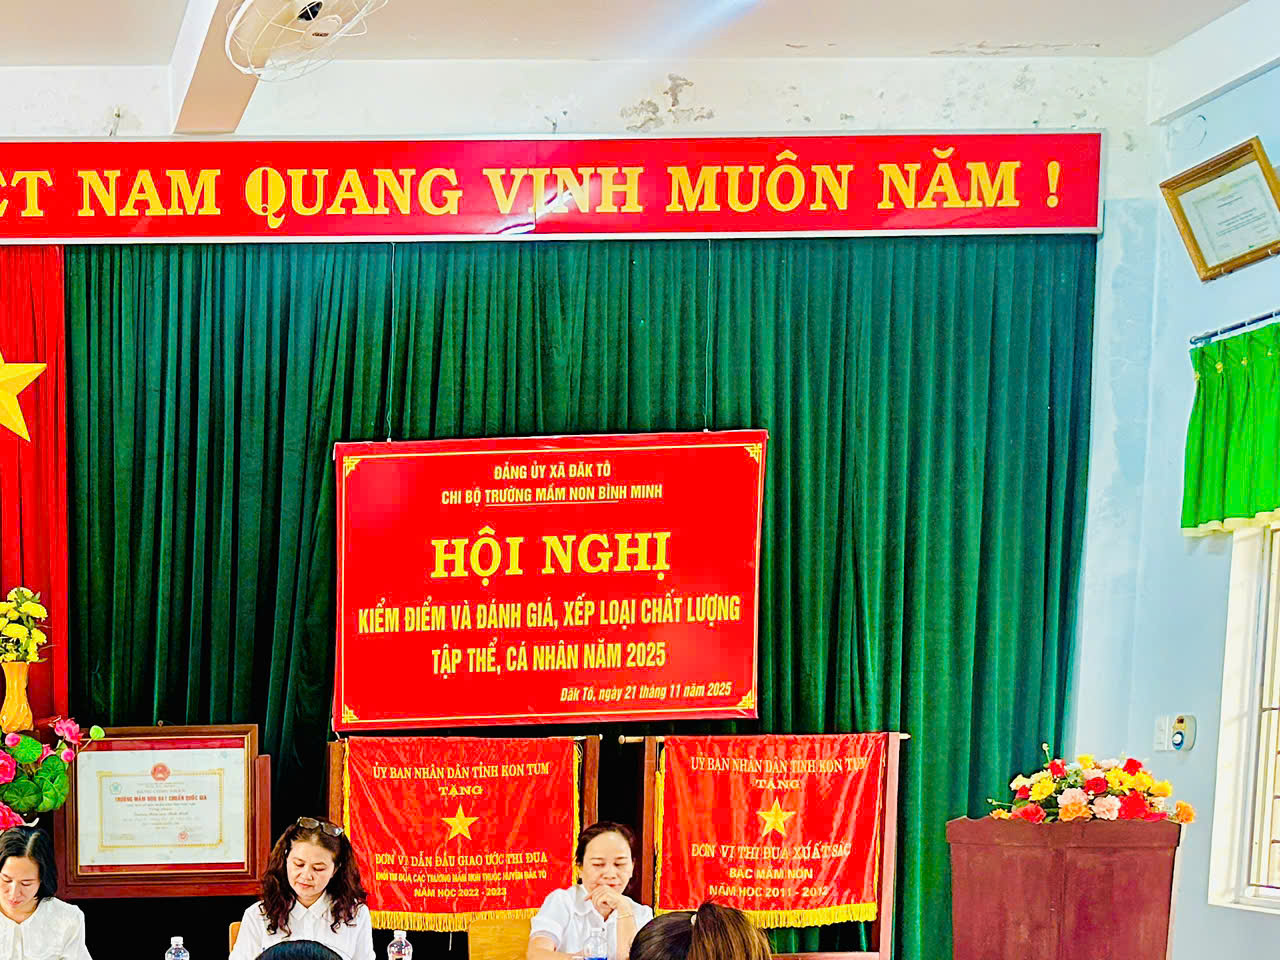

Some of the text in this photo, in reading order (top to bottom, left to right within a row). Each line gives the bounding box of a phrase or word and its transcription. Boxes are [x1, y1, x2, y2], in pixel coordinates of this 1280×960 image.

[78, 169, 220, 217] NAM
[245, 166, 464, 228] QUANG
[483, 166, 644, 214] VINH
[666, 149, 855, 213] MUÔN
[877, 147, 1020, 211] NĂM
[1047, 161, 1061, 208] !
[493, 461, 528, 480] ĐẢNG
[530, 459, 546, 479] ỦY
[549, 461, 566, 478] XÃ
[441, 490, 462, 505] CHI
[465, 486, 482, 506] BỘ
[485, 485, 532, 503] TRƯỜNG
[569, 486, 595, 501] NON
[598, 483, 627, 500] BÌNH
[630, 484, 663, 499] MINH
[430, 525, 671, 586] HỘI NGHỊ
[358, 589, 741, 634] KIỂM ĐIỂM VÀ ĐÁNH GIÁ, XẾP LOẠI CHẤT LƯỢNG
[432, 637, 666, 679] TẬP THỂ, CÁ NHÂN NĂM 2025
[599, 685, 623, 701] ngày
[624, 685, 637, 699] 21
[639, 684, 667, 700] tháng
[669, 684, 681, 697] 11
[683, 683, 706, 697] năm
[706, 681, 733, 697] 2025
[389, 766, 412, 779] BAN
[413, 763, 445, 779] NHÂN
[447, 763, 470, 779] DÂN
[501, 764, 525, 777] KON
[526, 762, 551, 776] TUM
[707, 756, 730, 771] BAN
[732, 754, 763, 773] NHÂN
[765, 755, 789, 773] DÂN
[819, 759, 843, 772] KON
[438, 785, 484, 797] TẶNG
[375, 853, 395, 865] ĐƠN
[458, 854, 483, 866] GIAO
[485, 851, 504, 866] ƯỚC
[505, 853, 523, 865] THI
[525, 852, 548, 864] ĐUA
[691, 843, 715, 858] ĐƠN
[738, 846, 760, 859] THI
[764, 846, 789, 860] ĐUA
[788, 867, 813, 879] NON
[414, 886, 436, 897] NĂM
[437, 887, 456, 899] HỌC
[458, 887, 479, 897] 2022
[486, 887, 507, 896] 2023
[709, 884, 736, 897] NĂM
[738, 886, 762, 899] HỌC
[765, 887, 792, 897] 2011
